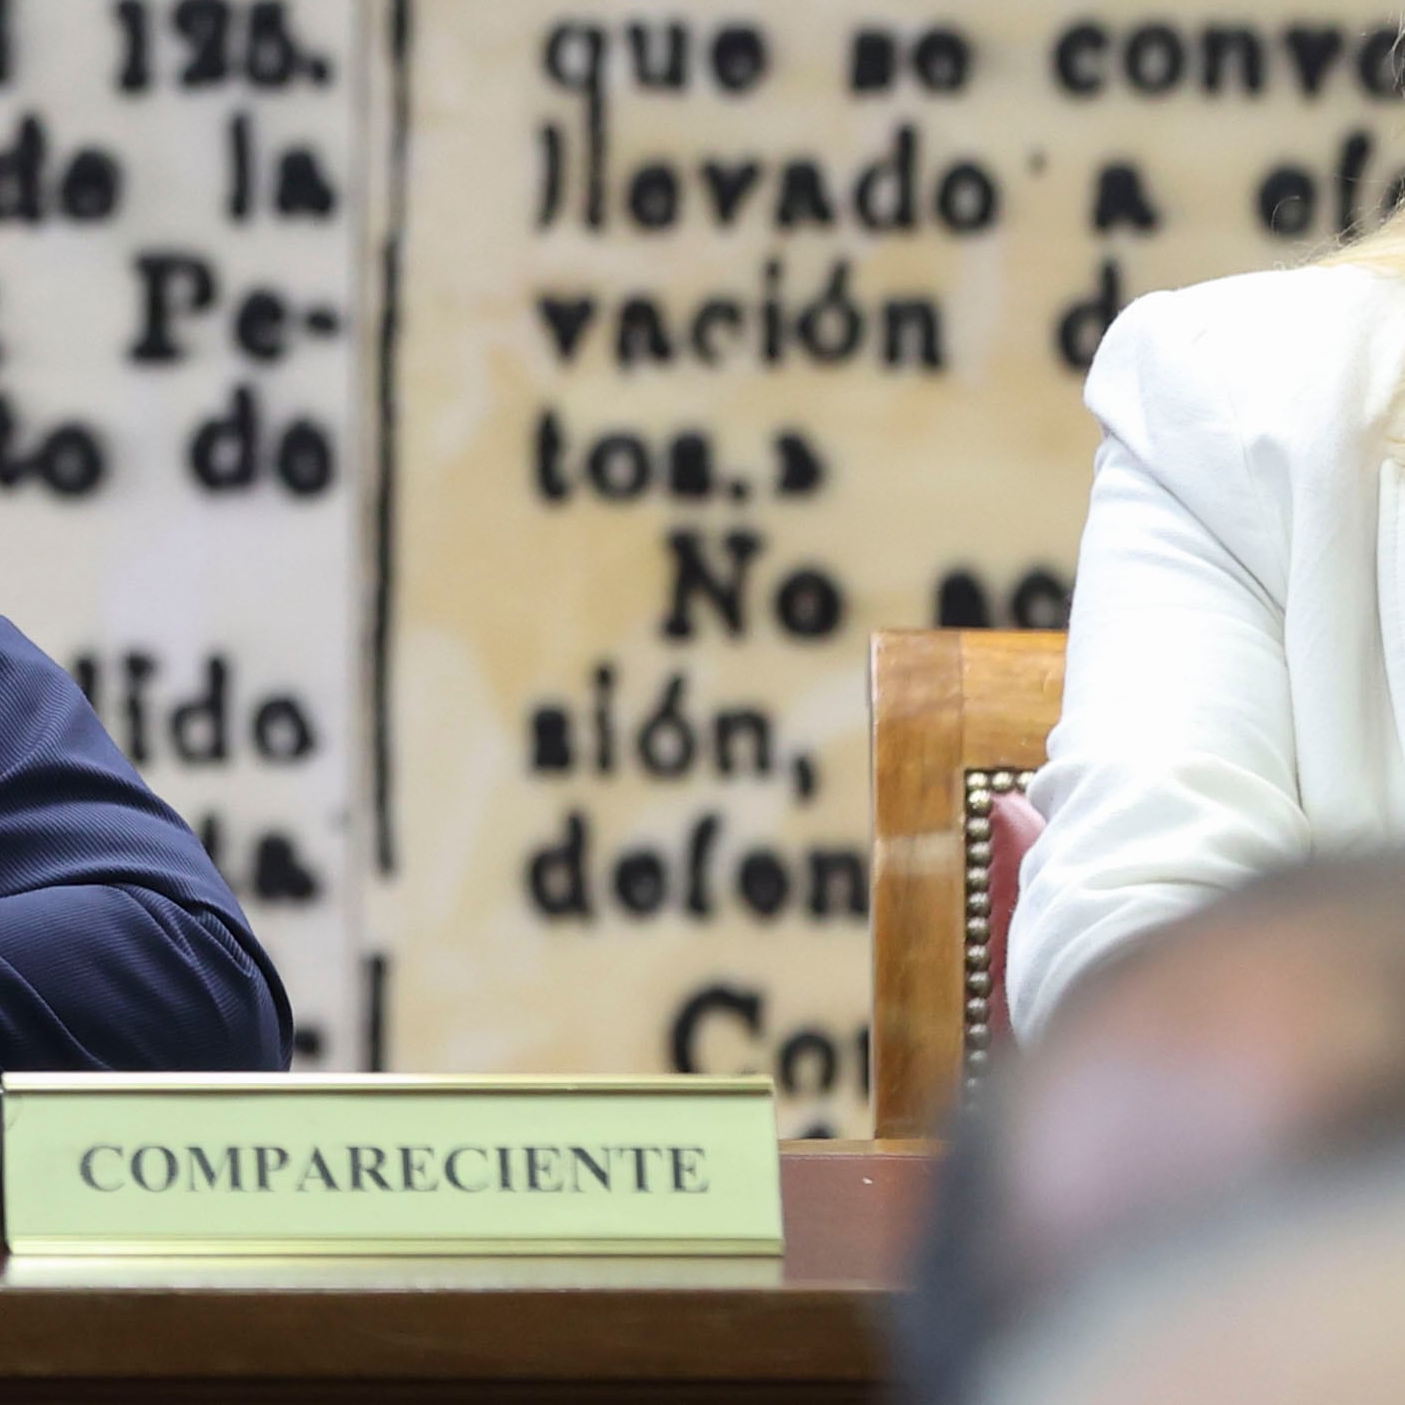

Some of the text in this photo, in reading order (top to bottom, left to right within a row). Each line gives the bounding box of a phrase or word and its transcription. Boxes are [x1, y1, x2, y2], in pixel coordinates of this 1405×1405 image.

[542, 22, 770, 120] que
[849, 28, 974, 95] se
[227, 113, 338, 223] la
[1091, 163, 1160, 235] a
[128, 250, 341, 368] Pe-
[536, 258, 946, 375] vación
[186, 383, 337, 501] de
[661, 527, 848, 644] No
[528, 662, 820, 804] sión,
[77, 1142, 711, 1198] COMPARECIENTE
